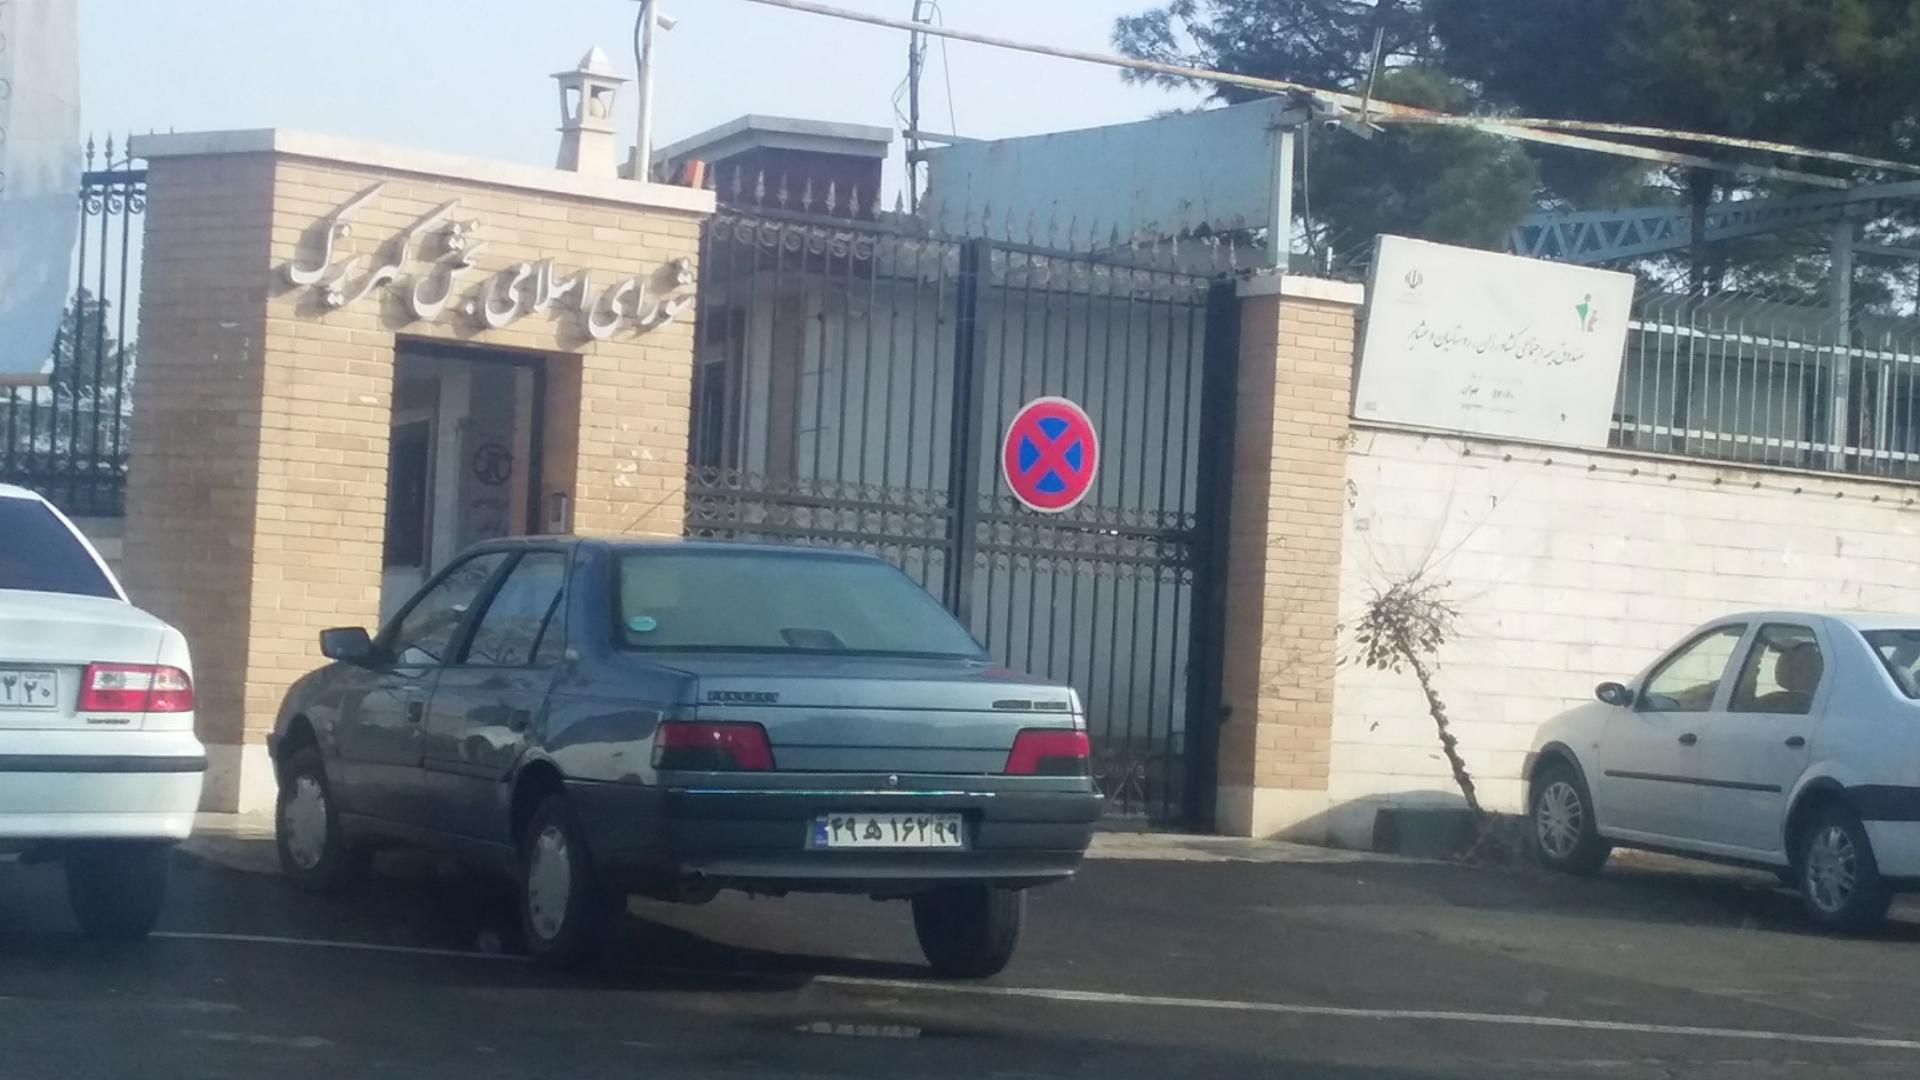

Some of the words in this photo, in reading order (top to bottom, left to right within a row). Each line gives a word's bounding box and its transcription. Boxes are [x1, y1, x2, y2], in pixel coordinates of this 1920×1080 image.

[289, 180, 462, 308] کهریزک
[412, 218, 489, 320] بخش
[484, 256, 592, 329] اسلامی
[588, 256, 696, 340] شورای
